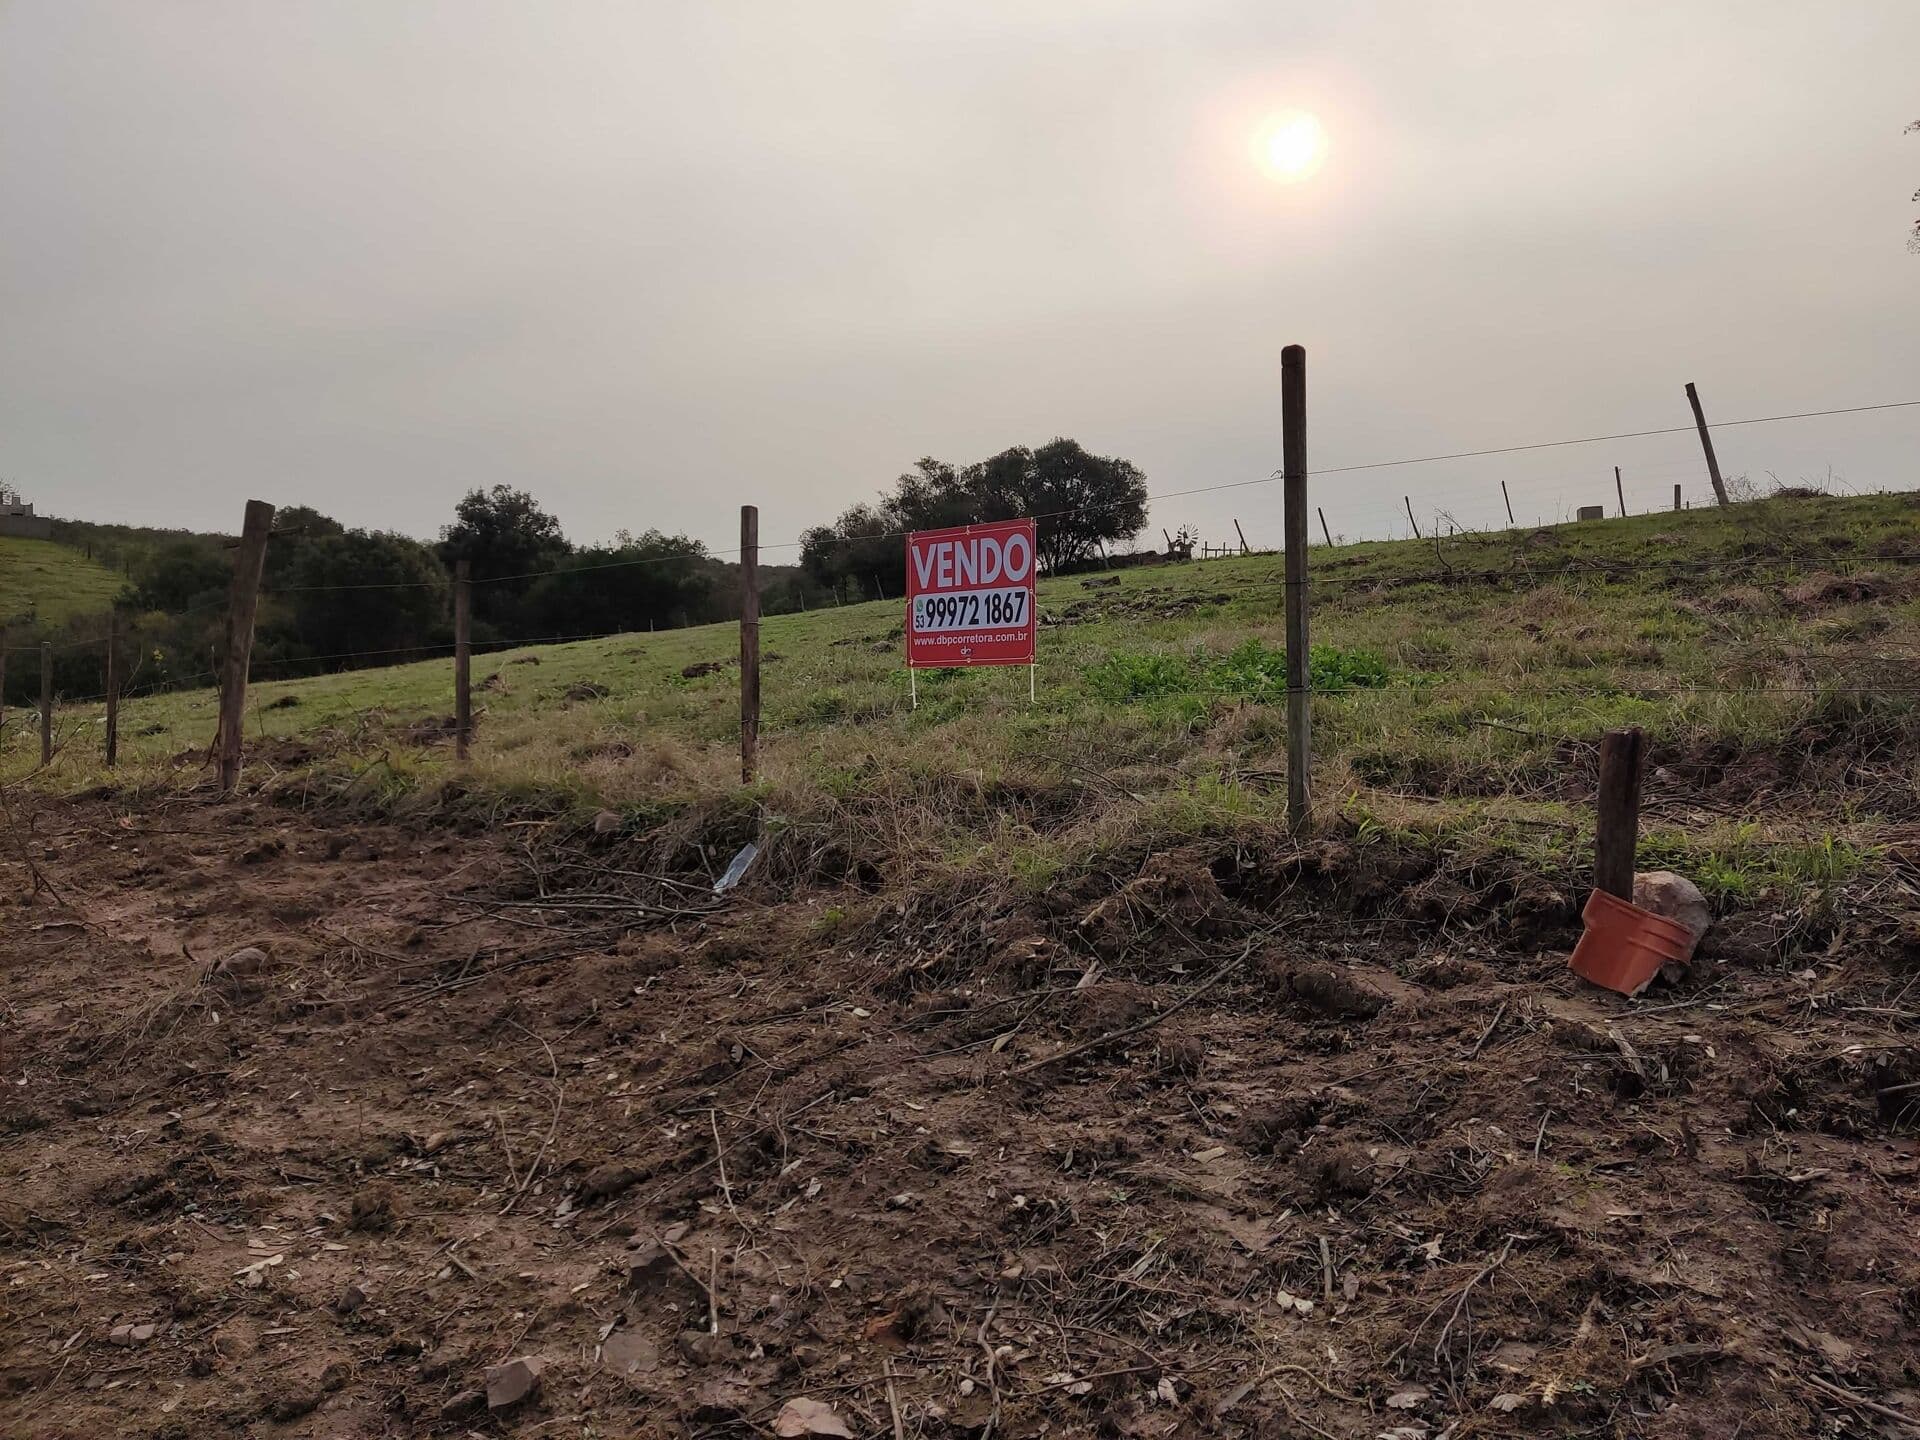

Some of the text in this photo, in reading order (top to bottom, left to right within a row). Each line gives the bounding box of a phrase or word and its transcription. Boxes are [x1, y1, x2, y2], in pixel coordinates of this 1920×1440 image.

[912, 533, 1031, 589] VENDO
[915, 591, 1026, 628] 53 99972 1867
[914, 631, 1028, 646] www.dbpcorretora.com.br
